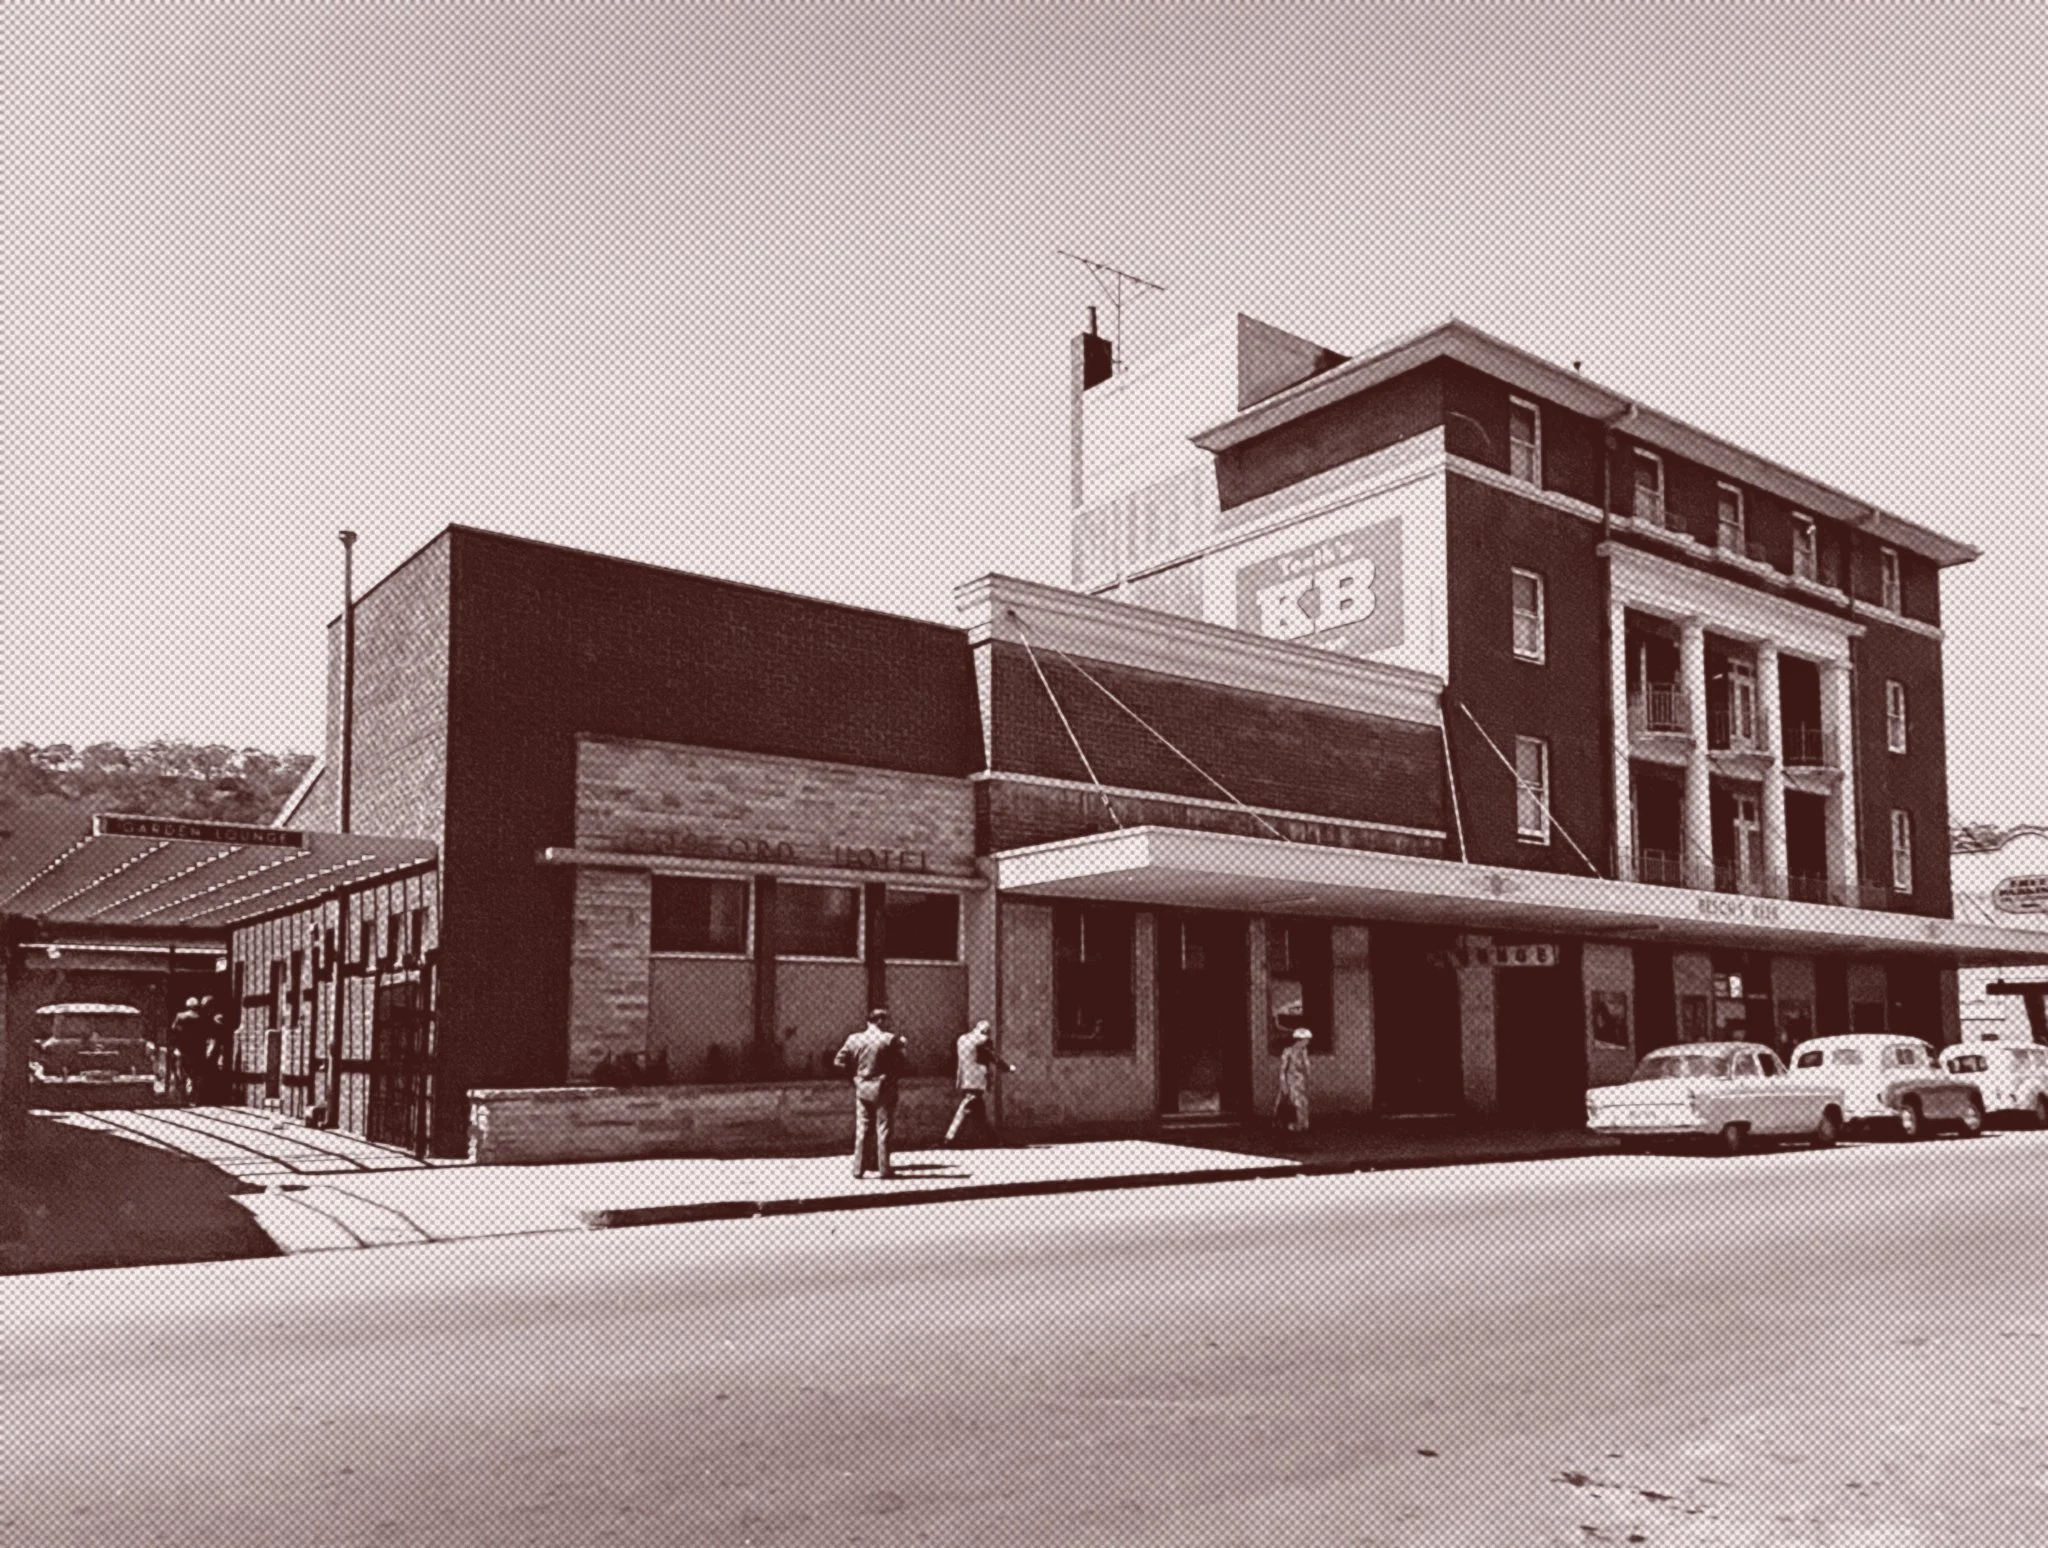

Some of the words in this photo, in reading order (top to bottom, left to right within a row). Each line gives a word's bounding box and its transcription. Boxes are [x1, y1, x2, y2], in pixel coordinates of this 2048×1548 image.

[1257, 558, 1378, 641] KB
[123, 822, 201, 838] GARDEN
[216, 830, 288, 844] LOUNGE
[833, 845, 928, 872] HOTEL
